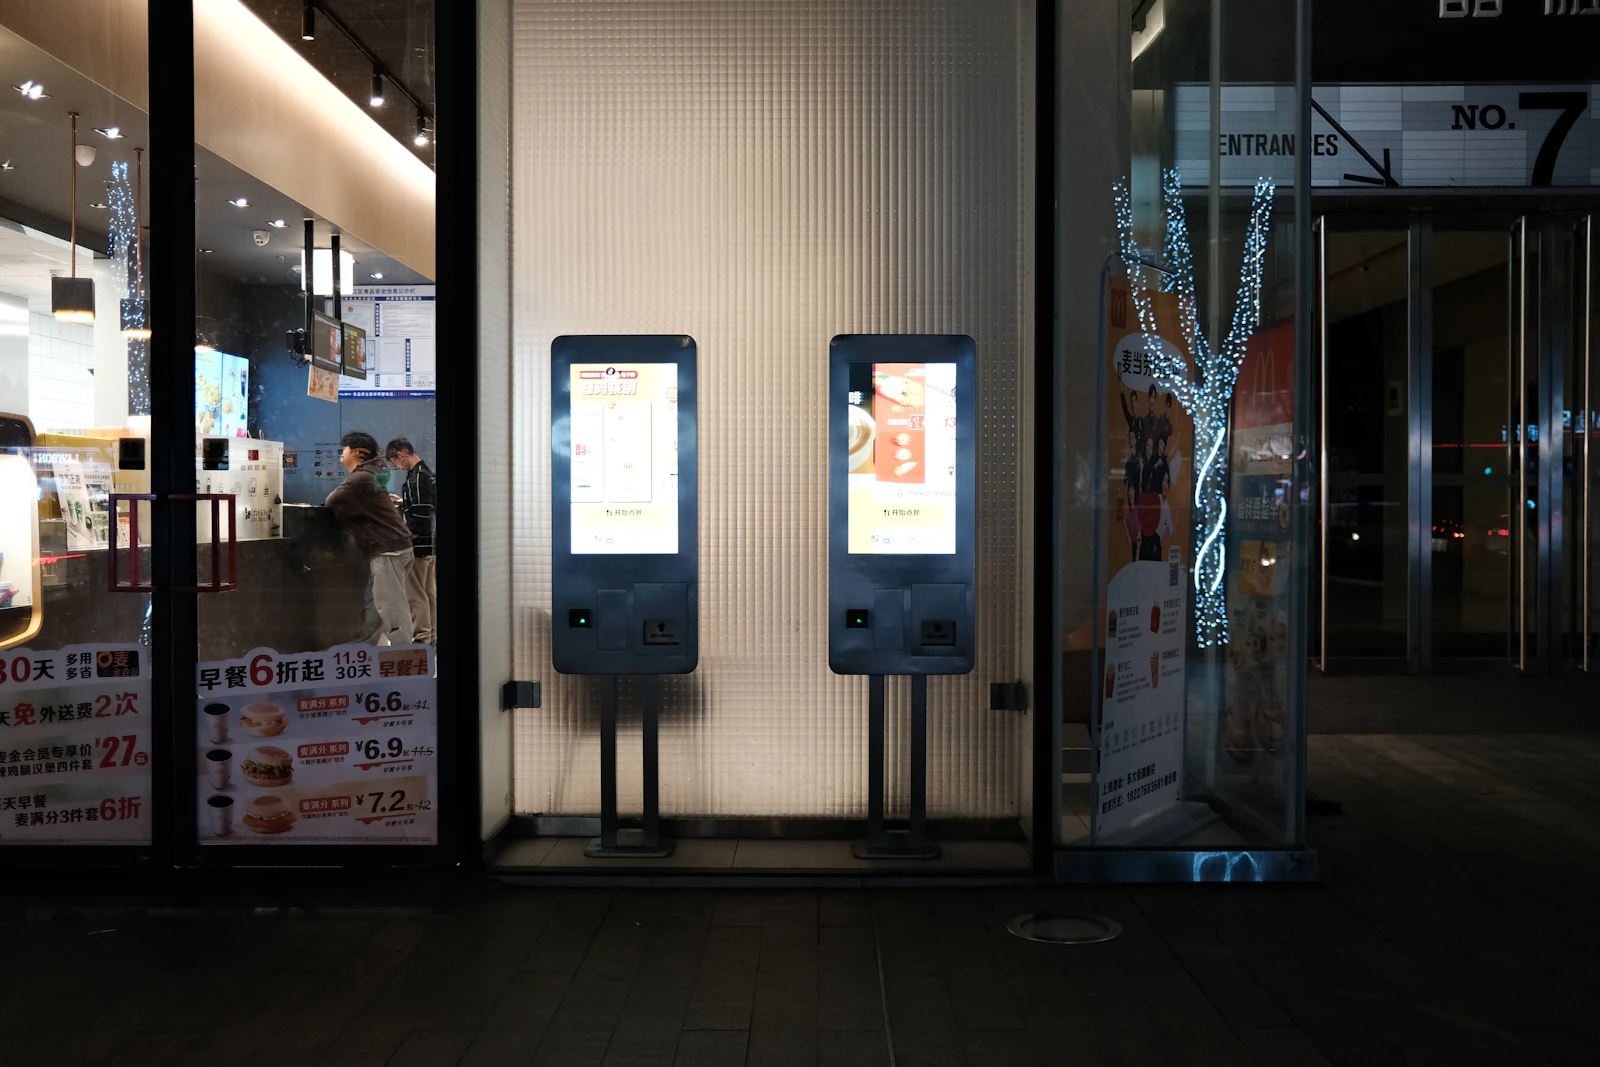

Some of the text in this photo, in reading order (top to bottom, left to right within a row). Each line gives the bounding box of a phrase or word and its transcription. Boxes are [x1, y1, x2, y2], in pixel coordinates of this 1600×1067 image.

[1218, 133, 1339, 157] ENTRANES
[1450, 91, 1589, 186] NO. 7
[66, 652, 92, 667] 多用
[66, 667, 92, 681] 多省
[335, 664, 372, 680] 30天
[379, 659, 428, 677] 早餐卡
[300, 696, 347, 710] 麦满分 系列
[300, 743, 347, 757] 麦满分 系列
[0, 794, 47, 811] 天早餐
[302, 797, 349, 811] 麦满分 系列
